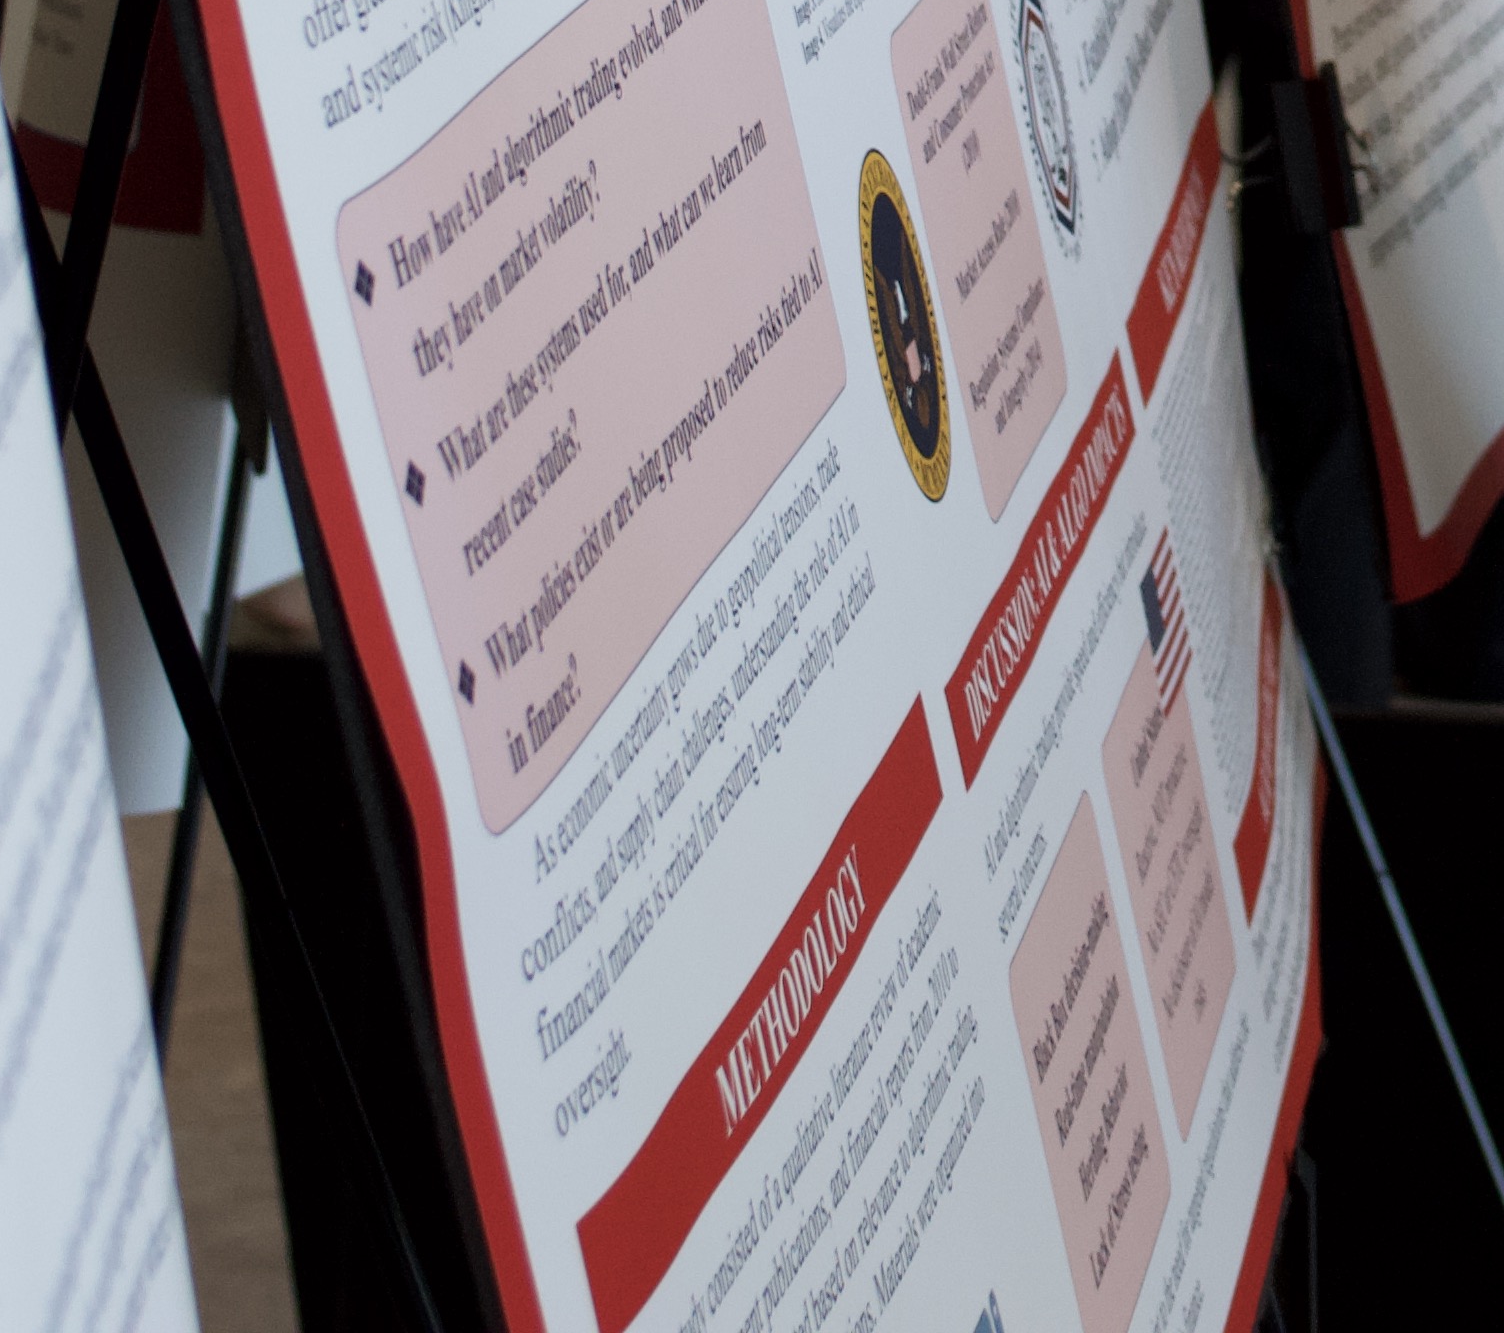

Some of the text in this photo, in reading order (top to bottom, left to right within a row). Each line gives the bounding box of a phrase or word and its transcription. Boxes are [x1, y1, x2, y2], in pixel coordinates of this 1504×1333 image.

[321, 63, 362, 129] and
[360, 22, 423, 113] systemic
[418, 0, 448, 57] risk
[386, 231, 433, 289] How
[427, 200, 467, 256] have
[462, 170, 484, 227] AI
[479, 147, 506, 207] and
[502, 89, 575, 187] algorithmic
[571, 56, 623, 119] trading
[617, 7, 664, 80] evolved,
[411, 158, 601, 378] they have on market volatility?
[435, 118, 767, 481] What are these systems used for, and what can we learn from
[461, 406, 582, 577] recent case studies?
[483, 245, 824, 677] What policies exist or are being proposed to reduce risks tied to AI
[504, 651, 582, 775] in finance?
[533, 436, 841, 885] As economic uncertainty grows due to geopolitical tensions, trade
[706, 883, 942, 1316] consisted of a qualitative literature review of academic
[714, 842, 866, 1137] METHODOLOGY
